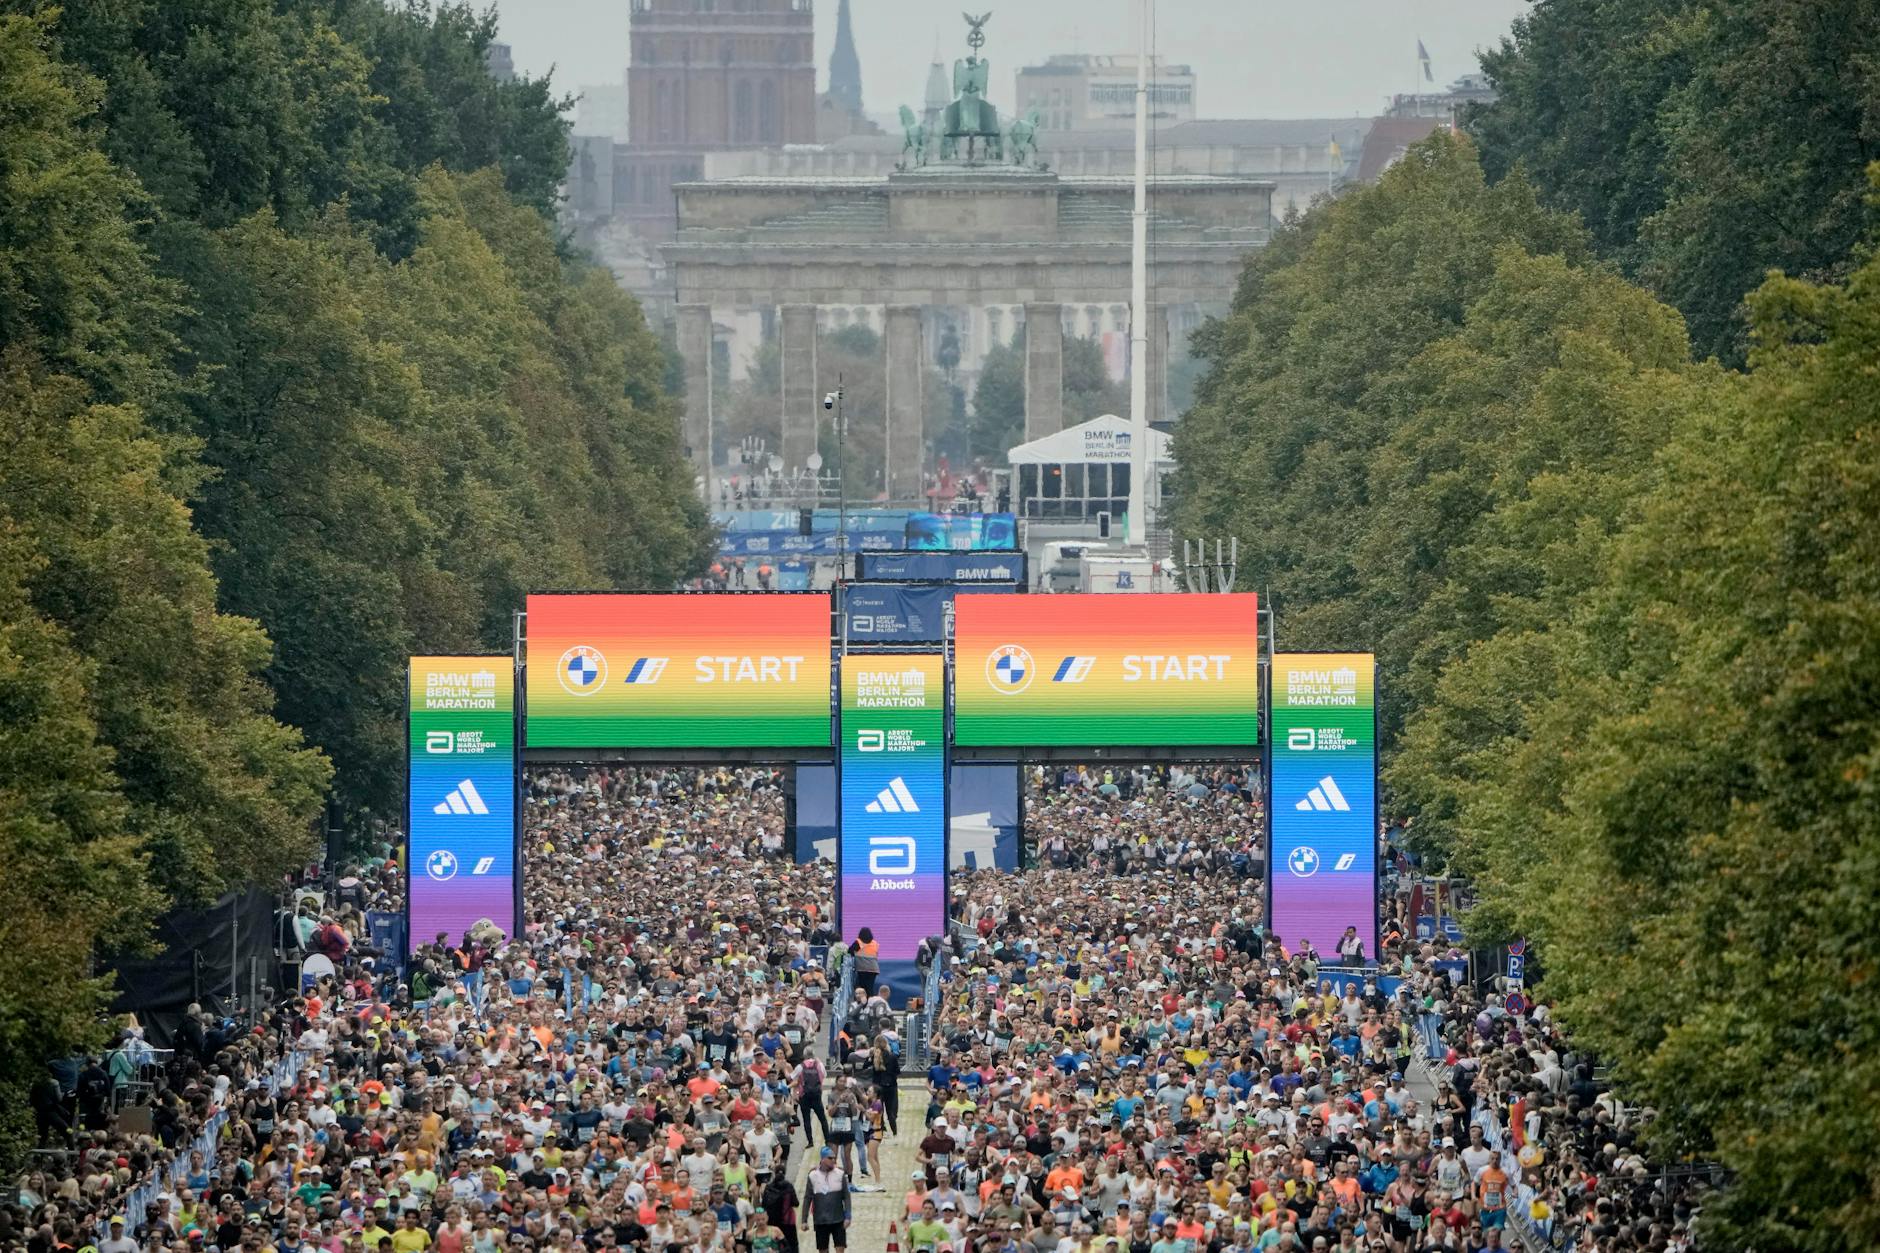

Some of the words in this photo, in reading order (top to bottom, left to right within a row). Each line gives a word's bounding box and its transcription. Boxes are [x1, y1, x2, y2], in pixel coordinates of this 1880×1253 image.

[1084, 431, 1113, 440] BMW
[956, 568, 989, 579] BMW
[1120, 575, 1128, 585] K
[695, 656, 805, 683] START
[1122, 655, 1231, 681] START
[427, 672, 469, 686] BMW
[857, 672, 900, 686] BMW
[1288, 671, 1330, 684] BMW
[427, 687, 470, 697] BERLIN
[857, 687, 900, 696] BERLIN
[1288, 685, 1331, 694] BERLIN
[427, 699, 496, 708] MARATHON
[857, 698, 925, 707] MARATHON
[1288, 696, 1356, 705] MARATHON
[870, 879, 915, 890] Abbott
[1510, 957, 1519, 976] P
